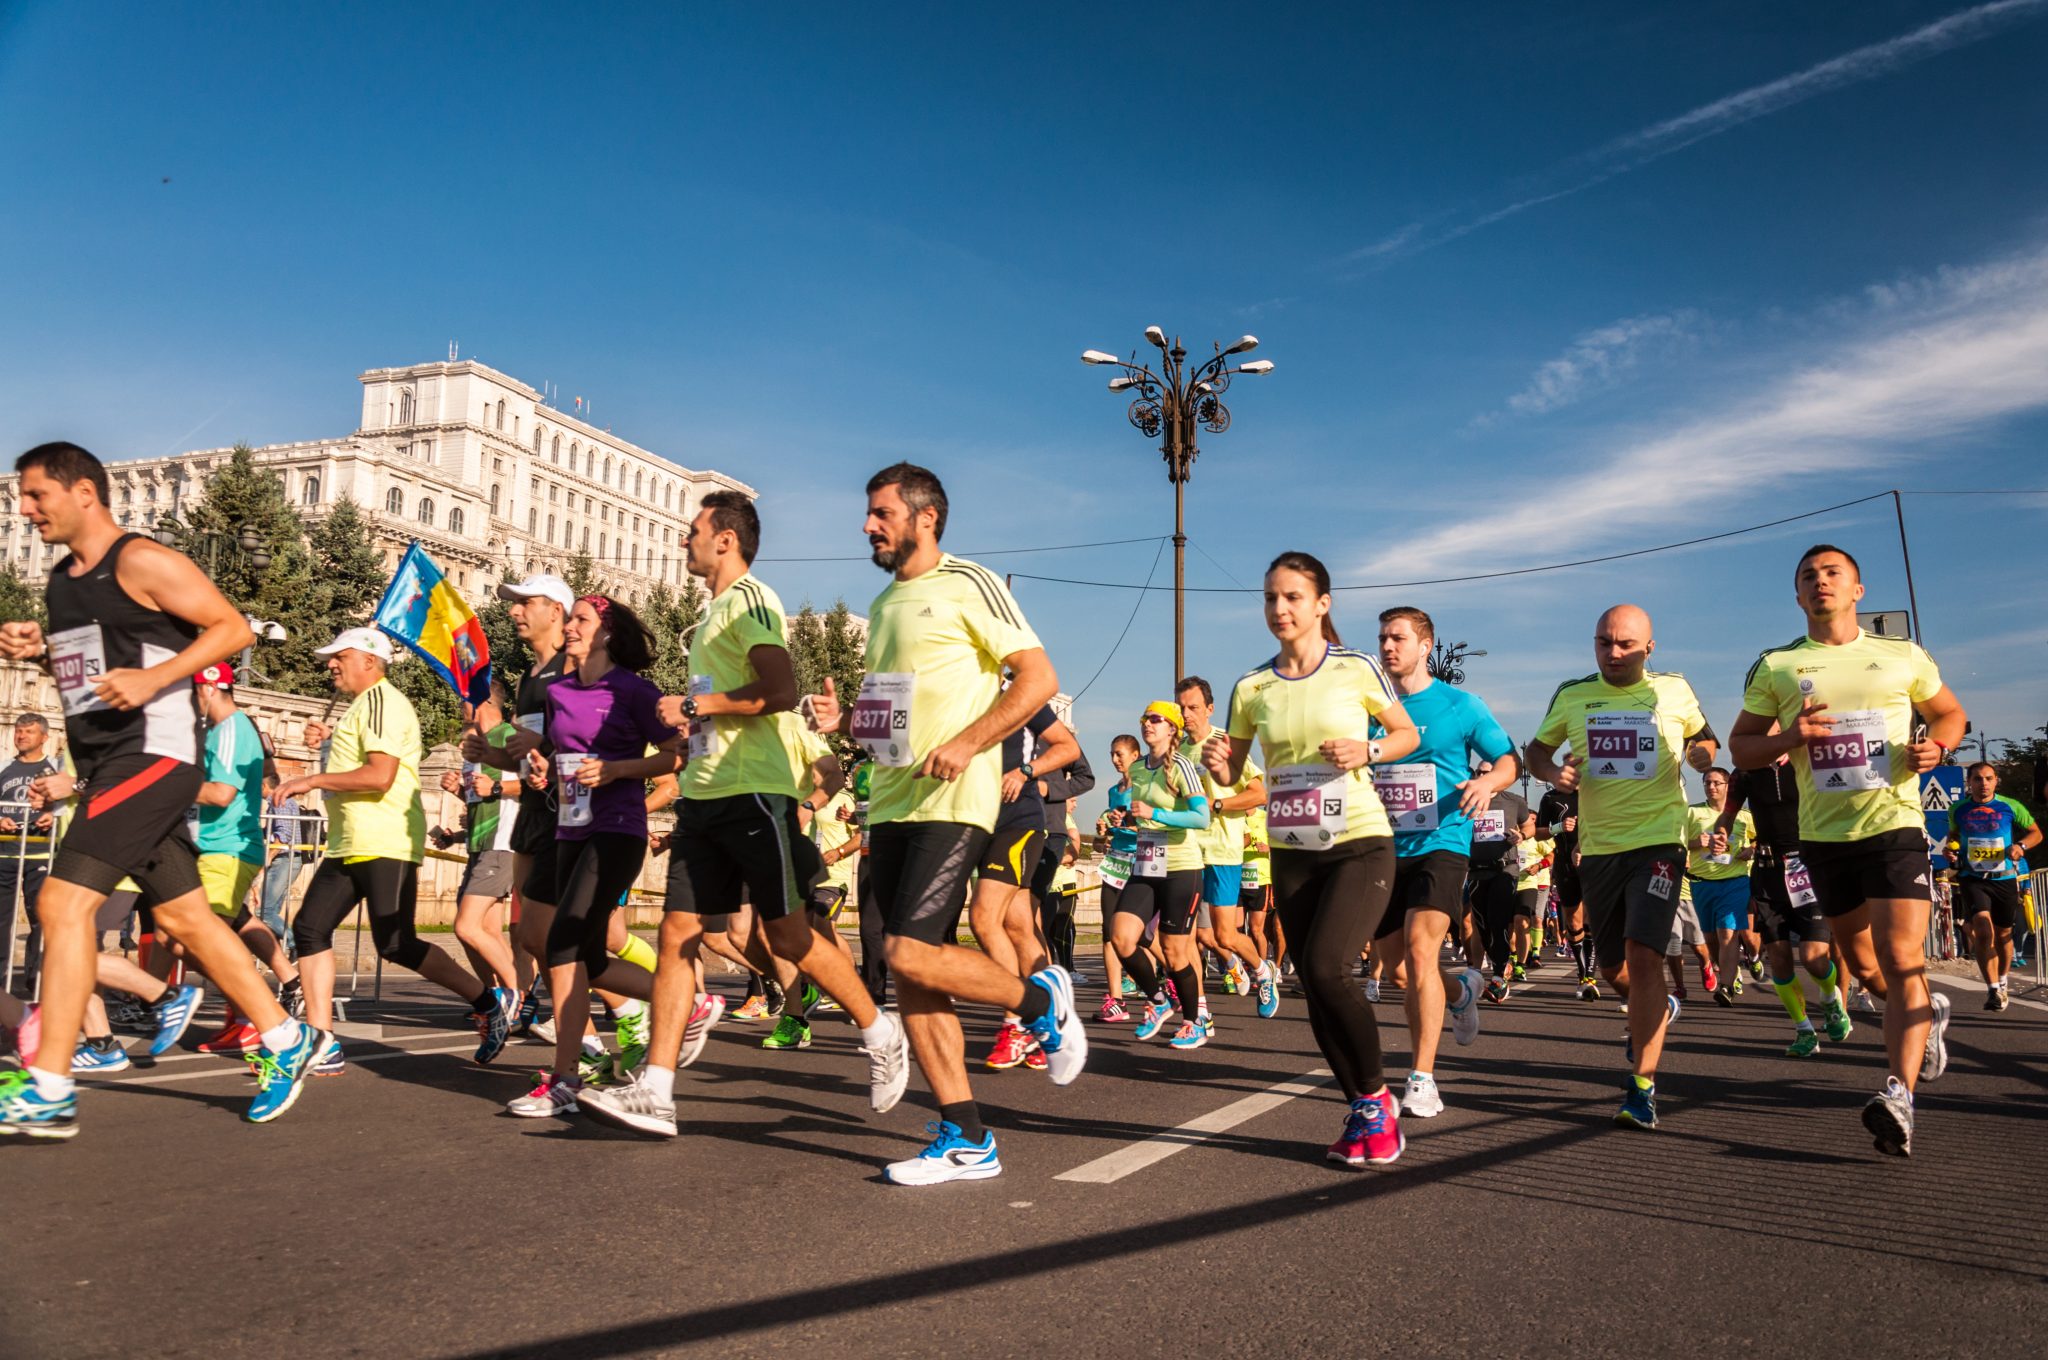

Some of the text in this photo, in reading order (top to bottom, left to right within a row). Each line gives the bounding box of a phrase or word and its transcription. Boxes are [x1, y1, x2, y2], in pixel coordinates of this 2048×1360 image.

[854, 710, 889, 728] 8377
[1592, 736, 1630, 751] 7611
[1813, 742, 1861, 761] 5193
[1377, 787, 1414, 801] 9335
[1271, 798, 1317, 818] 9656
[1974, 850, 2000, 859] 3217
